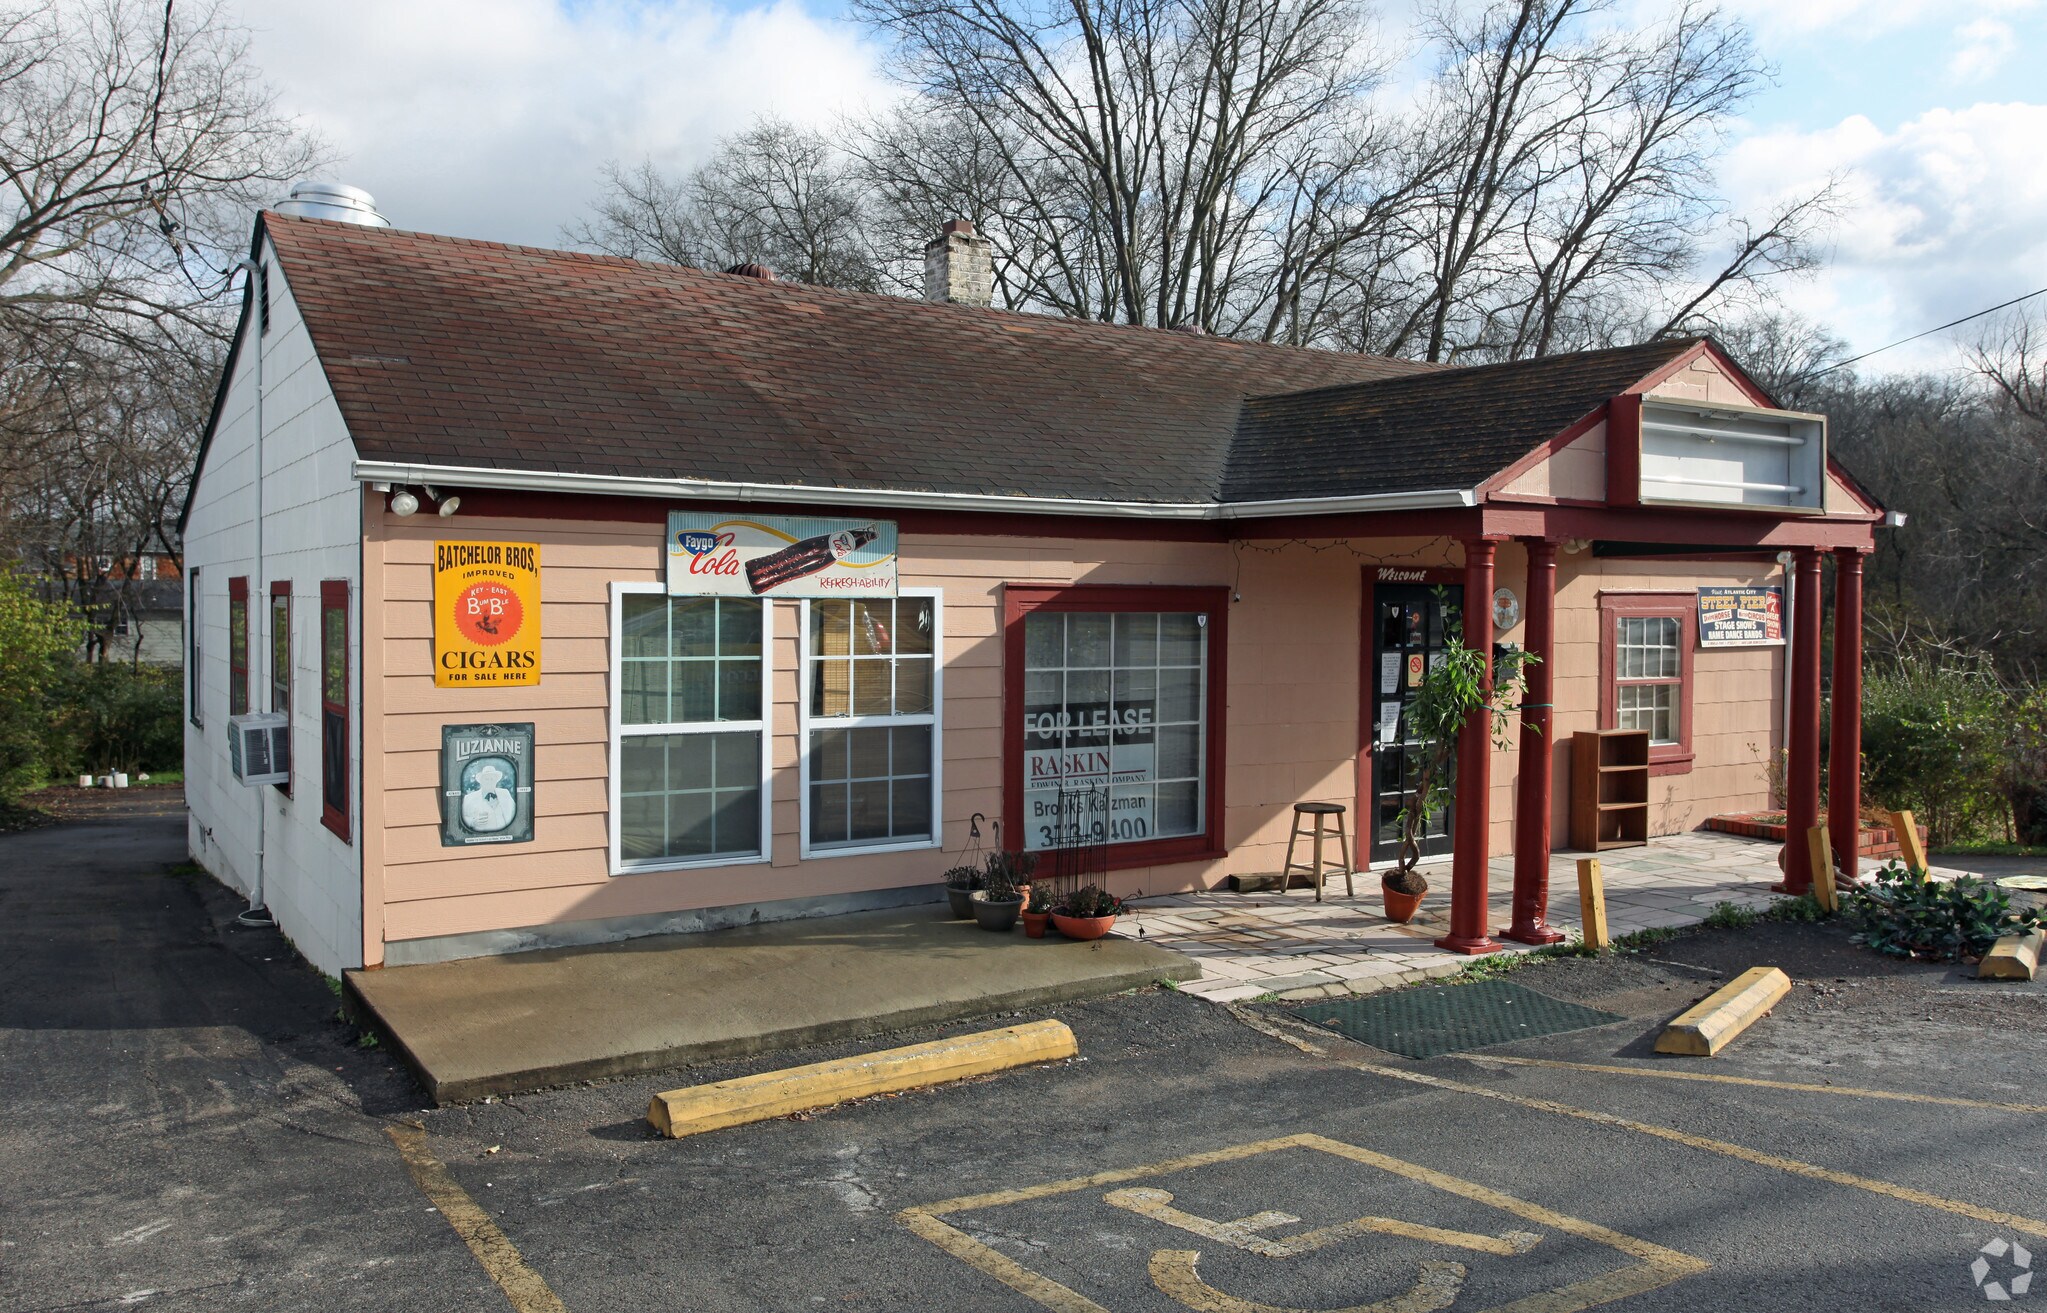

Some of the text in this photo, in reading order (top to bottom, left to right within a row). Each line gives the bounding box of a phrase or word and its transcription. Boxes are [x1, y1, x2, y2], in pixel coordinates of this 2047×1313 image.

[685, 534, 714, 551] Faygo
[438, 545, 501, 573] BATCHELOR
[689, 532, 740, 576] Cola
[463, 569, 515, 580] IMPROVED
[1378, 567, 1427, 581] WELCOME
[471, 587, 484, 597] KEY
[491, 586, 508, 596] EAST
[1701, 595, 1738, 609] STEEL
[1739, 595, 1766, 609] PIER
[1714, 621, 1757, 630] STAGE SHOWS
[1725, 631, 1743, 639] DANCE
[1744, 630, 1763, 639] BANDS
[441, 650, 536, 669] CIGARS
[449, 672, 527, 681] FOR SALE HERE
[1024, 708, 1152, 740] FOR LEASE
[456, 738, 521, 761] LUZIANNE
[1031, 752, 1109, 776] RASKIN
[1111, 774, 1147, 783] OMPANY
[1089, 796, 1146, 812] Kazman
